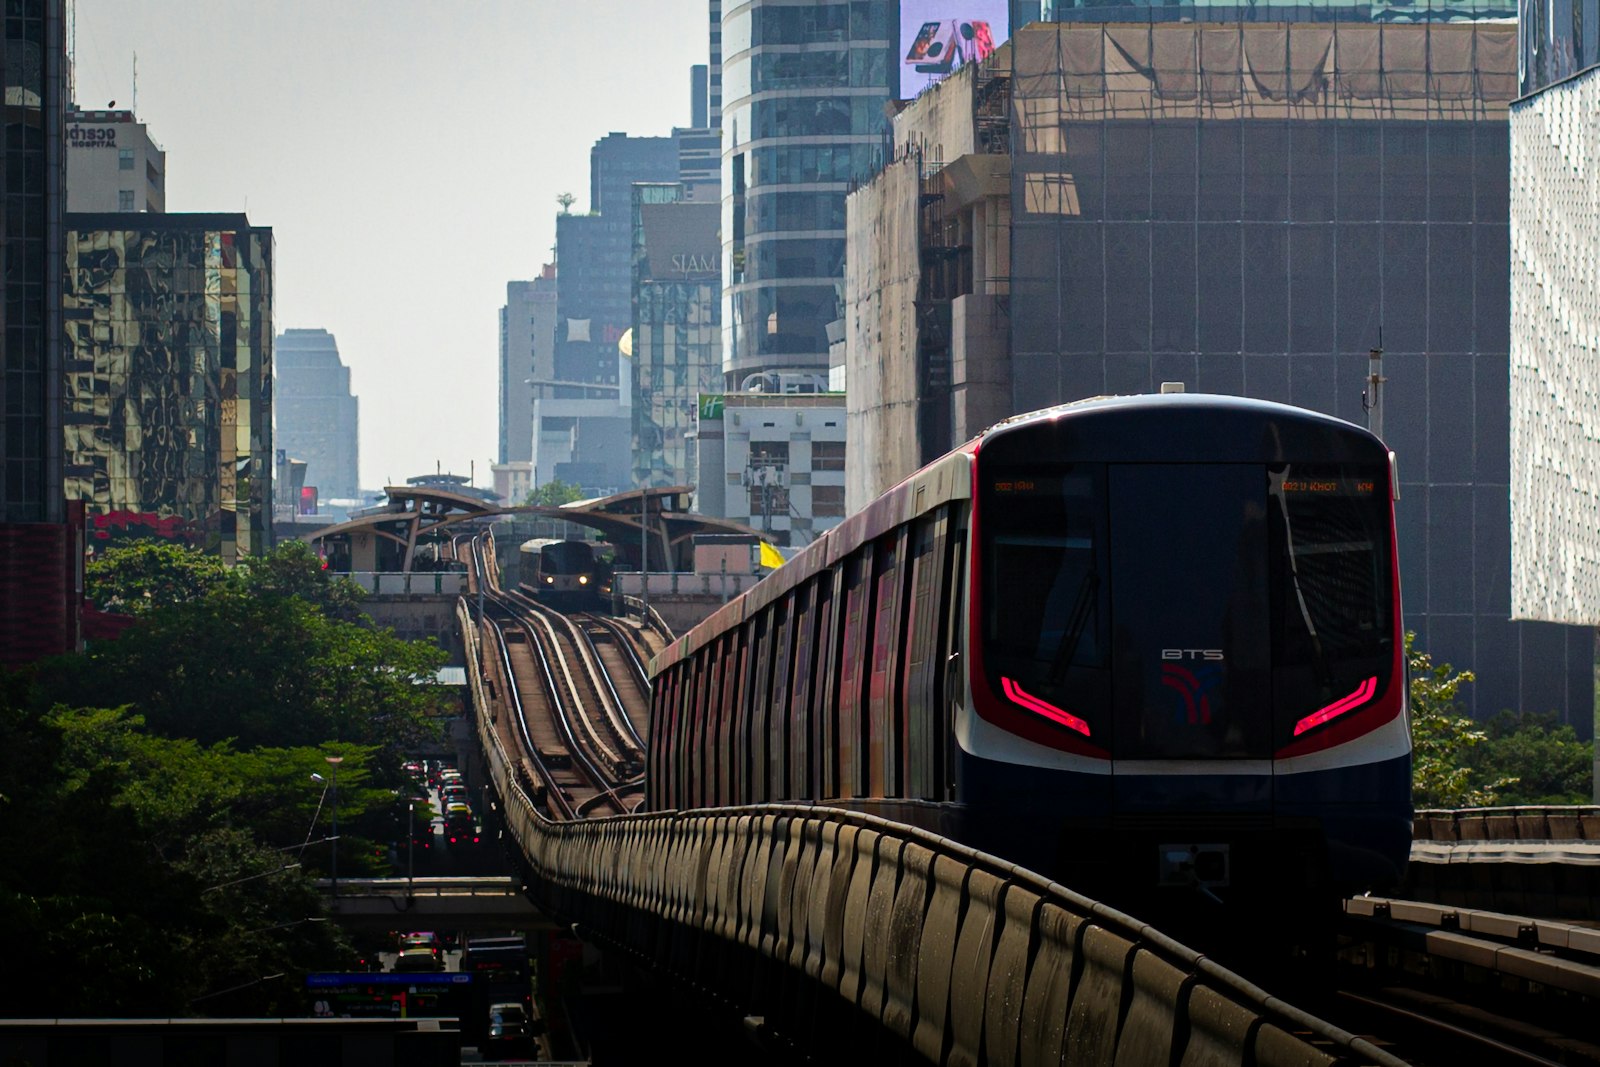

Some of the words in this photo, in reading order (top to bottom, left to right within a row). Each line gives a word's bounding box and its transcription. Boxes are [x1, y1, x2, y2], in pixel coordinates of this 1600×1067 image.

[71, 140, 117, 148] HOSPITAL
[671, 253, 717, 273] SIAM
[1161, 648, 1225, 660] BTS
